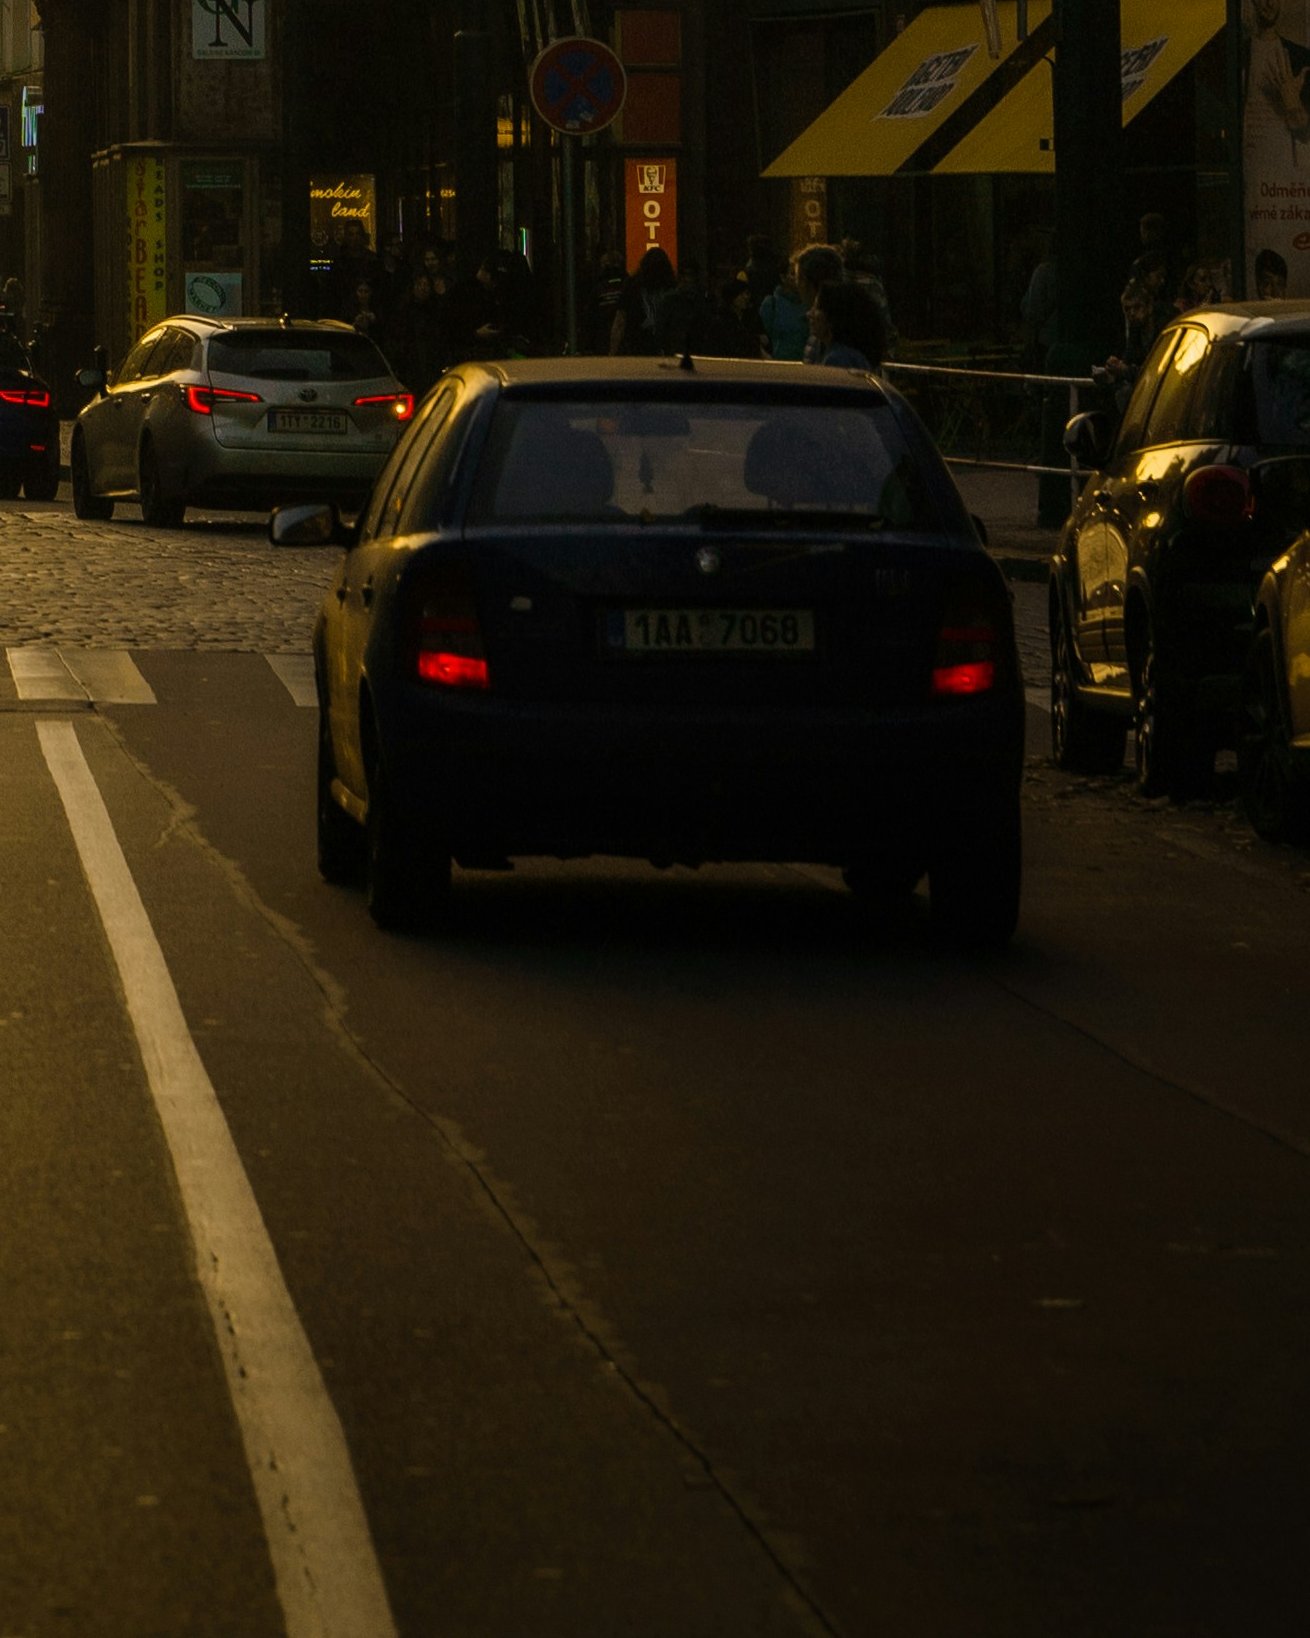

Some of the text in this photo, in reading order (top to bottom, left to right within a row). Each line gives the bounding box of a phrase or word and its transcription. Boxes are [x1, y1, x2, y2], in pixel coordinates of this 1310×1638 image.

[331, 201, 371, 218] land
[642, 200, 662, 251] OT
[280, 415, 341, 429] 1TY 2216
[635, 614, 800, 645] 1AA 7068
